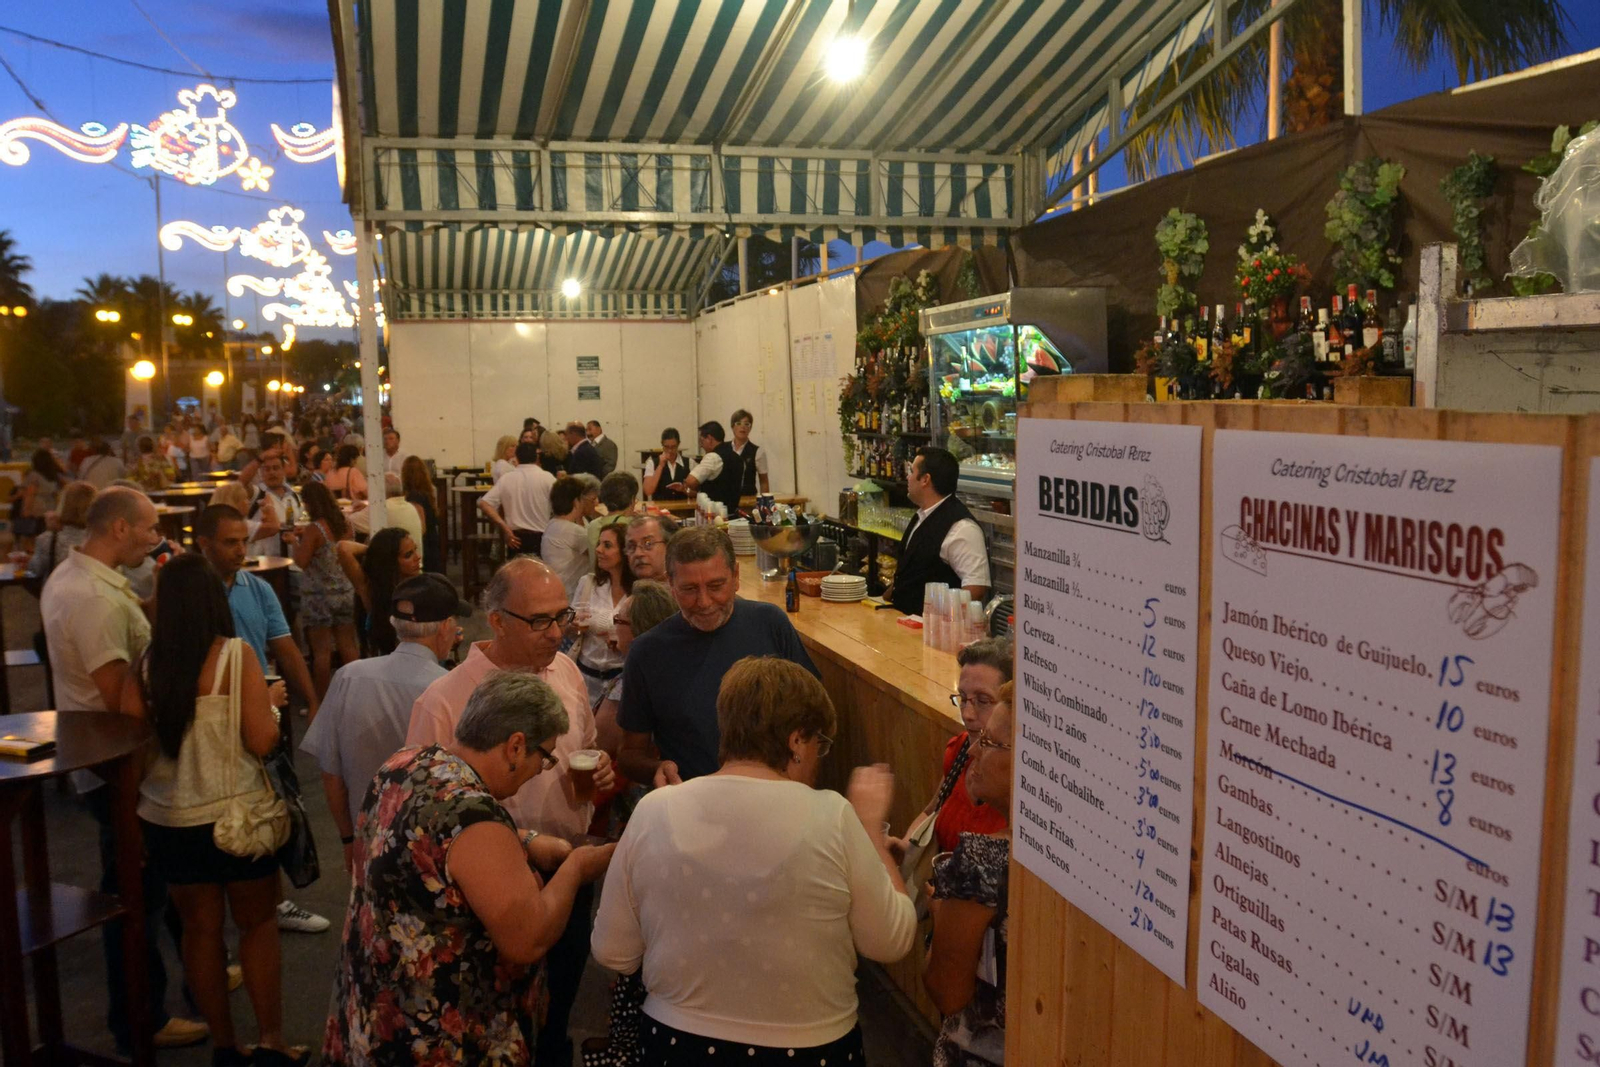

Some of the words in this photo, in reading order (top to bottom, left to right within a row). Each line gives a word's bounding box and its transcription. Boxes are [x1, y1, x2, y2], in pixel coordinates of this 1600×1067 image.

[1050, 439, 1084, 461] Catering
[1086, 442, 1126, 460] Cristobal
[1271, 458, 1332, 488] Catering
[1335, 463, 1407, 489] Cristobal
[1038, 475, 1140, 528] BEBIDAS
[1240, 495, 1341, 556] CHACINAS
[1346, 509, 1359, 558] Y
[1364, 511, 1505, 582] MARISCOS
[1024, 540, 1070, 566] Manzanilla
[1165, 583, 1187, 596] euros
[1024, 567, 1070, 594] Manzanilla
[1144, 598, 1160, 628] 5
[1164, 615, 1186, 630] euros
[1023, 620, 1055, 645] Cerveza
[1162, 680, 1184, 695] euros
[1024, 594, 1044, 615] Rioja
[1142, 634, 1156, 658] 12
[1163, 648, 1185, 662] euros
[1222, 602, 1268, 632] Jamón
[1272, 614, 1328, 647] Ibérico
[1336, 635, 1353, 656] de
[1439, 655, 1475, 687] 15
[1476, 680, 1521, 702] euros
[1023, 646, 1058, 673] Refresco
[1162, 712, 1183, 728] euros
[1023, 672, 1052, 700] Whisky
[1054, 687, 1107, 724] Combinado
[1160, 743, 1182, 760] euros
[1221, 671, 1256, 700] Caña
[1260, 687, 1277, 708] de
[1281, 692, 1328, 726] Lomo
[1332, 710, 1393, 751] Ibérica
[1431, 750, 1457, 786] 13
[1470, 770, 1515, 796] euros
[1222, 637, 1266, 666] Queso
[1436, 701, 1464, 733] 10
[1473, 724, 1518, 749] euros
[1022, 724, 1052, 752] Licores
[1053, 740, 1081, 769] Varios
[1159, 806, 1180, 824] euros
[1023, 698, 1052, 727] Whisky
[1054, 715, 1064, 731] 12
[1066, 724, 1087, 743] años
[1160, 774, 1181, 792] euros
[1220, 706, 1261, 738] Carne
[1265, 723, 1336, 769] Mechada
[1436, 789, 1454, 826] 8
[1468, 815, 1513, 842] euros
[1020, 774, 1036, 797] Ron
[1038, 787, 1063, 813] Añejo
[1136, 848, 1145, 869] 4
[1156, 867, 1178, 887] euros
[1021, 750, 1047, 776] Comb.
[1049, 767, 1059, 783] de
[1061, 773, 1105, 811] Cubalibre
[1157, 836, 1179, 856] euros
[1219, 739, 1274, 780] Morcón
[1466, 861, 1510, 887] euros
[1019, 825, 1044, 854] Frutos
[1046, 844, 1070, 874] Secos
[1154, 928, 1175, 949] euros
[1020, 800, 1048, 831] Patatas
[1155, 898, 1176, 919] euros
[1217, 806, 1301, 869] Langostinos
[1431, 921, 1476, 964] S/M
[1483, 940, 1514, 976] 13
[1218, 774, 1273, 817] Gambas
[1434, 878, 1479, 920] S/M
[1485, 896, 1515, 932] 13
[1210, 940, 1260, 986] Cigalas
[1212, 905, 1247, 943] Patas
[1250, 930, 1293, 974] Rusas
[1213, 874, 1285, 933] Ortiguillas
[1425, 1004, 1471, 1050] S/M
[1215, 841, 1269, 887] Almejas
[1428, 962, 1473, 1006] S/M
[1209, 972, 1247, 1010] Aliño
